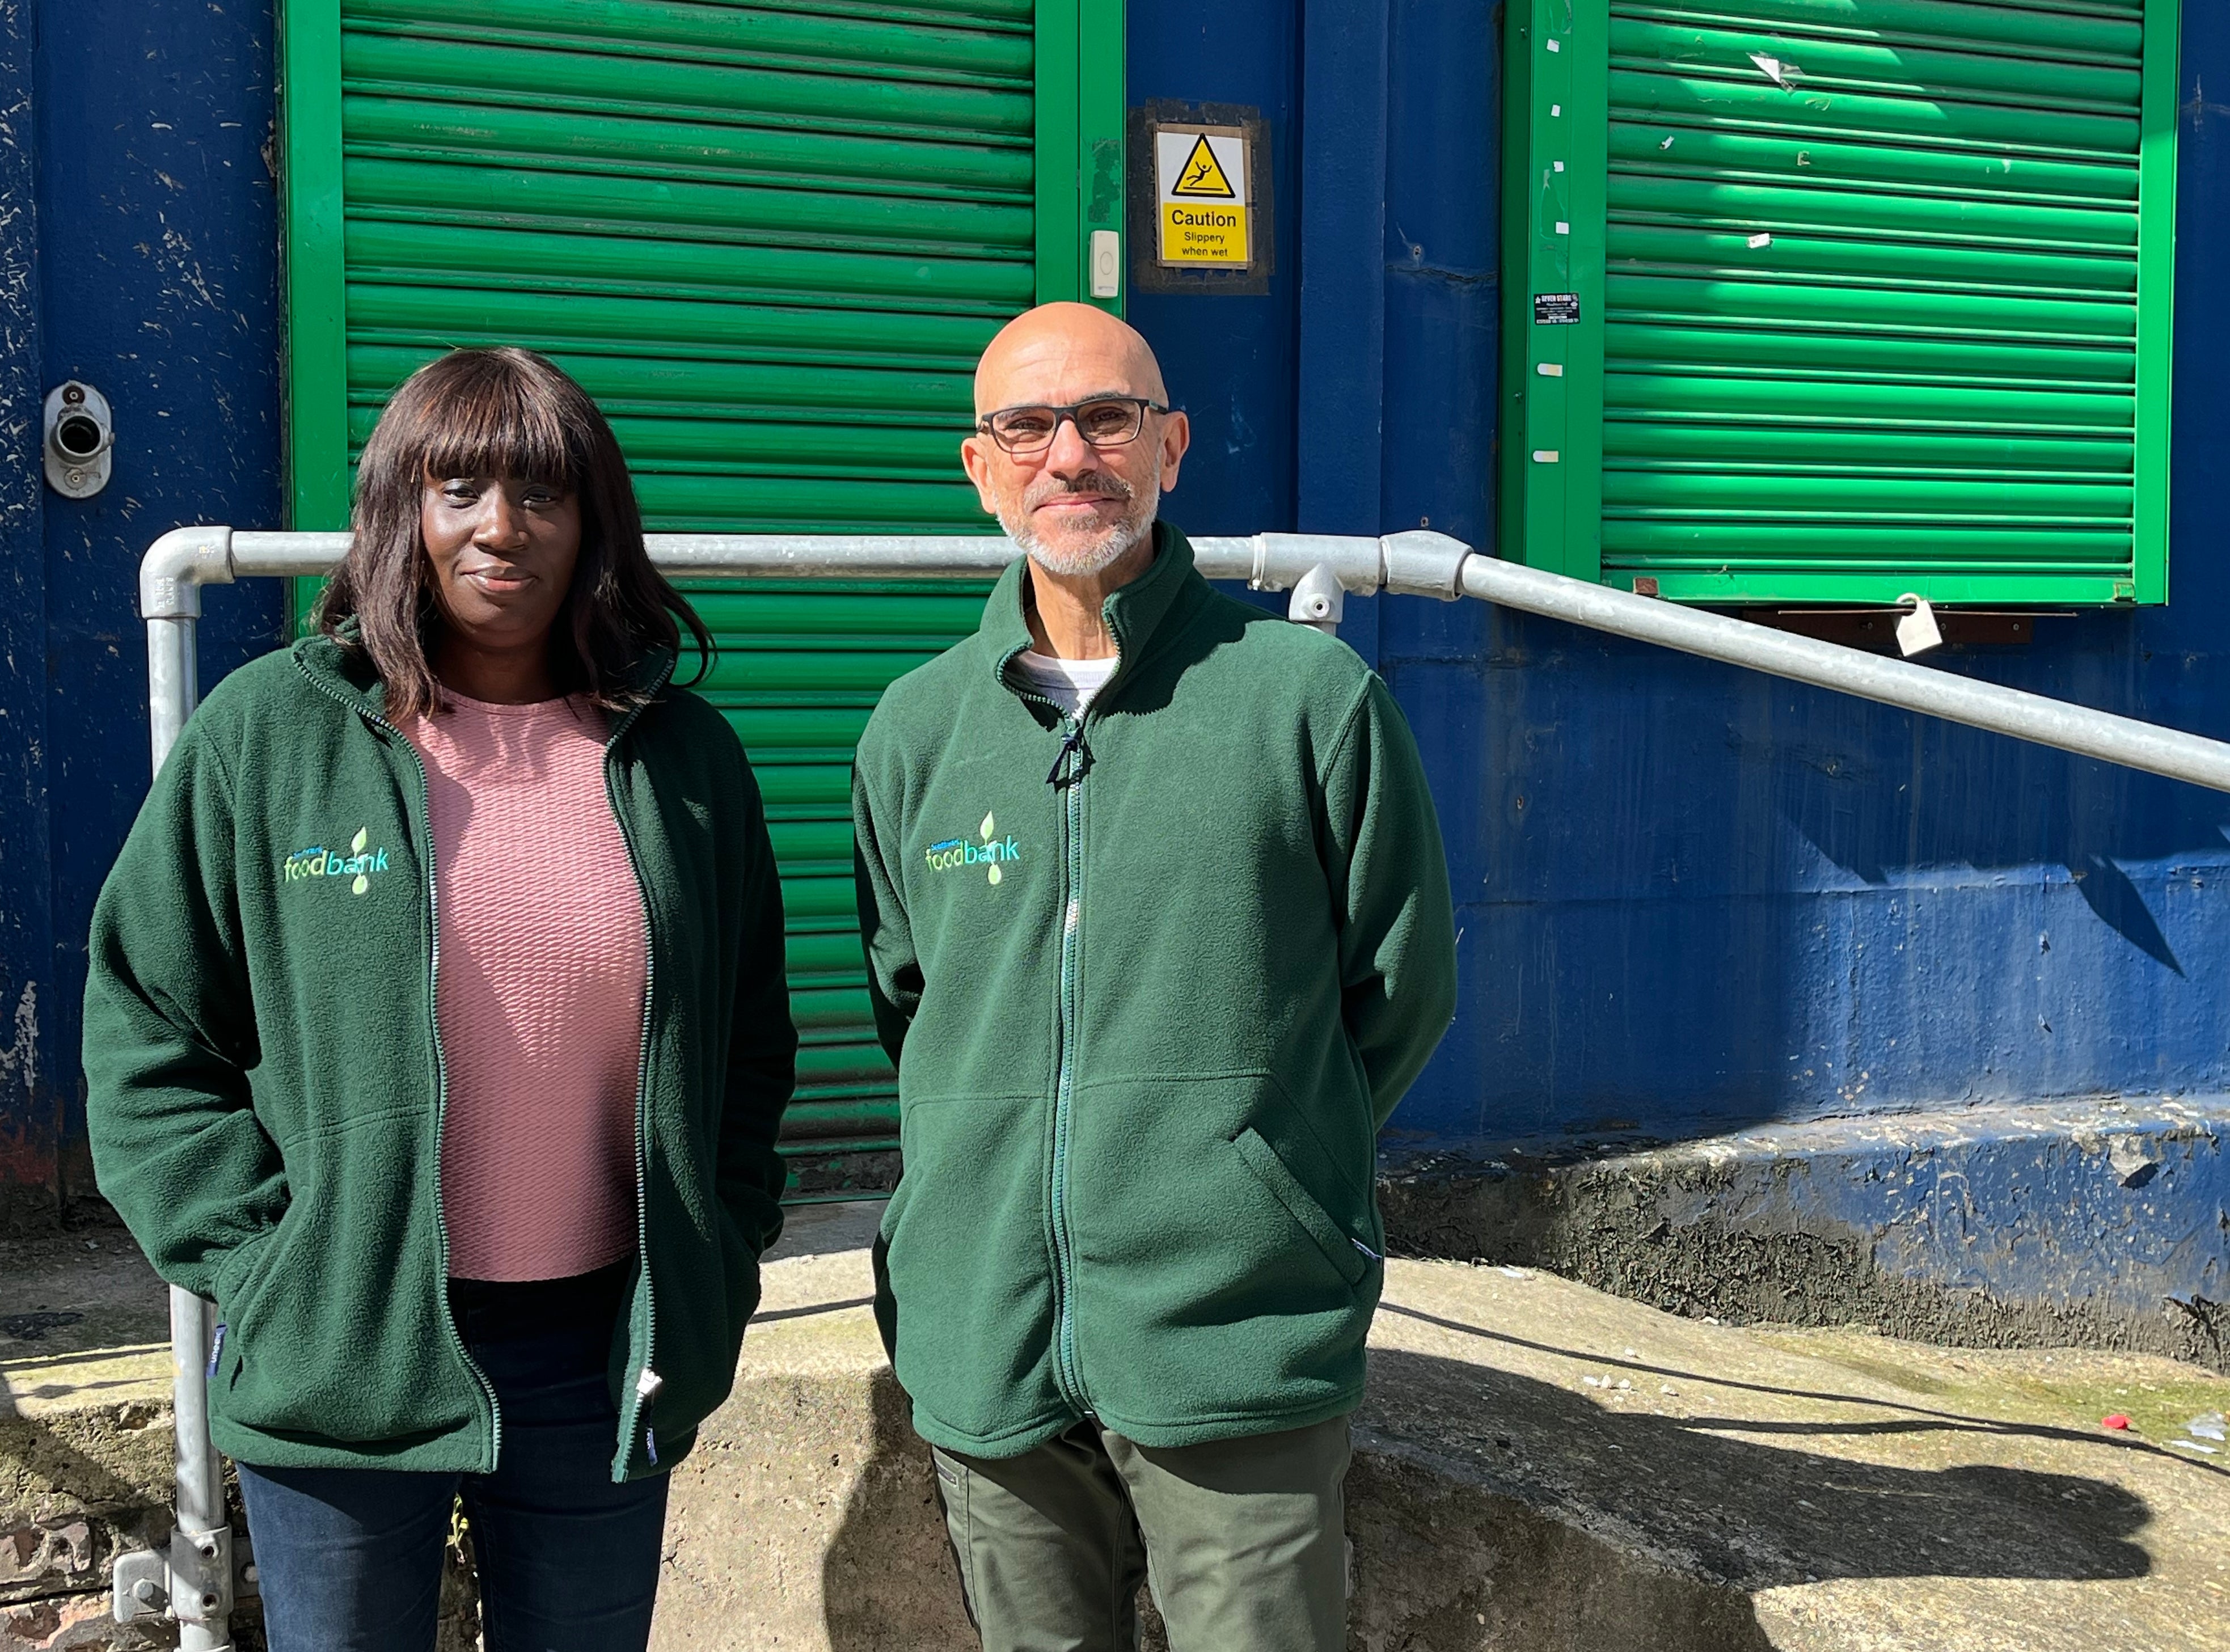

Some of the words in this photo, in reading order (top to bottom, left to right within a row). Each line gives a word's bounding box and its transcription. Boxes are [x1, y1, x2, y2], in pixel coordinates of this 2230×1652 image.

[1172, 209, 1236, 227] Caution
[1184, 231, 1225, 244] Slippery
[1182, 246, 1208, 256] when
[1211, 247, 1228, 257] wet
[925, 835, 1020, 873] foodbank
[284, 847, 388, 883] foodbank
